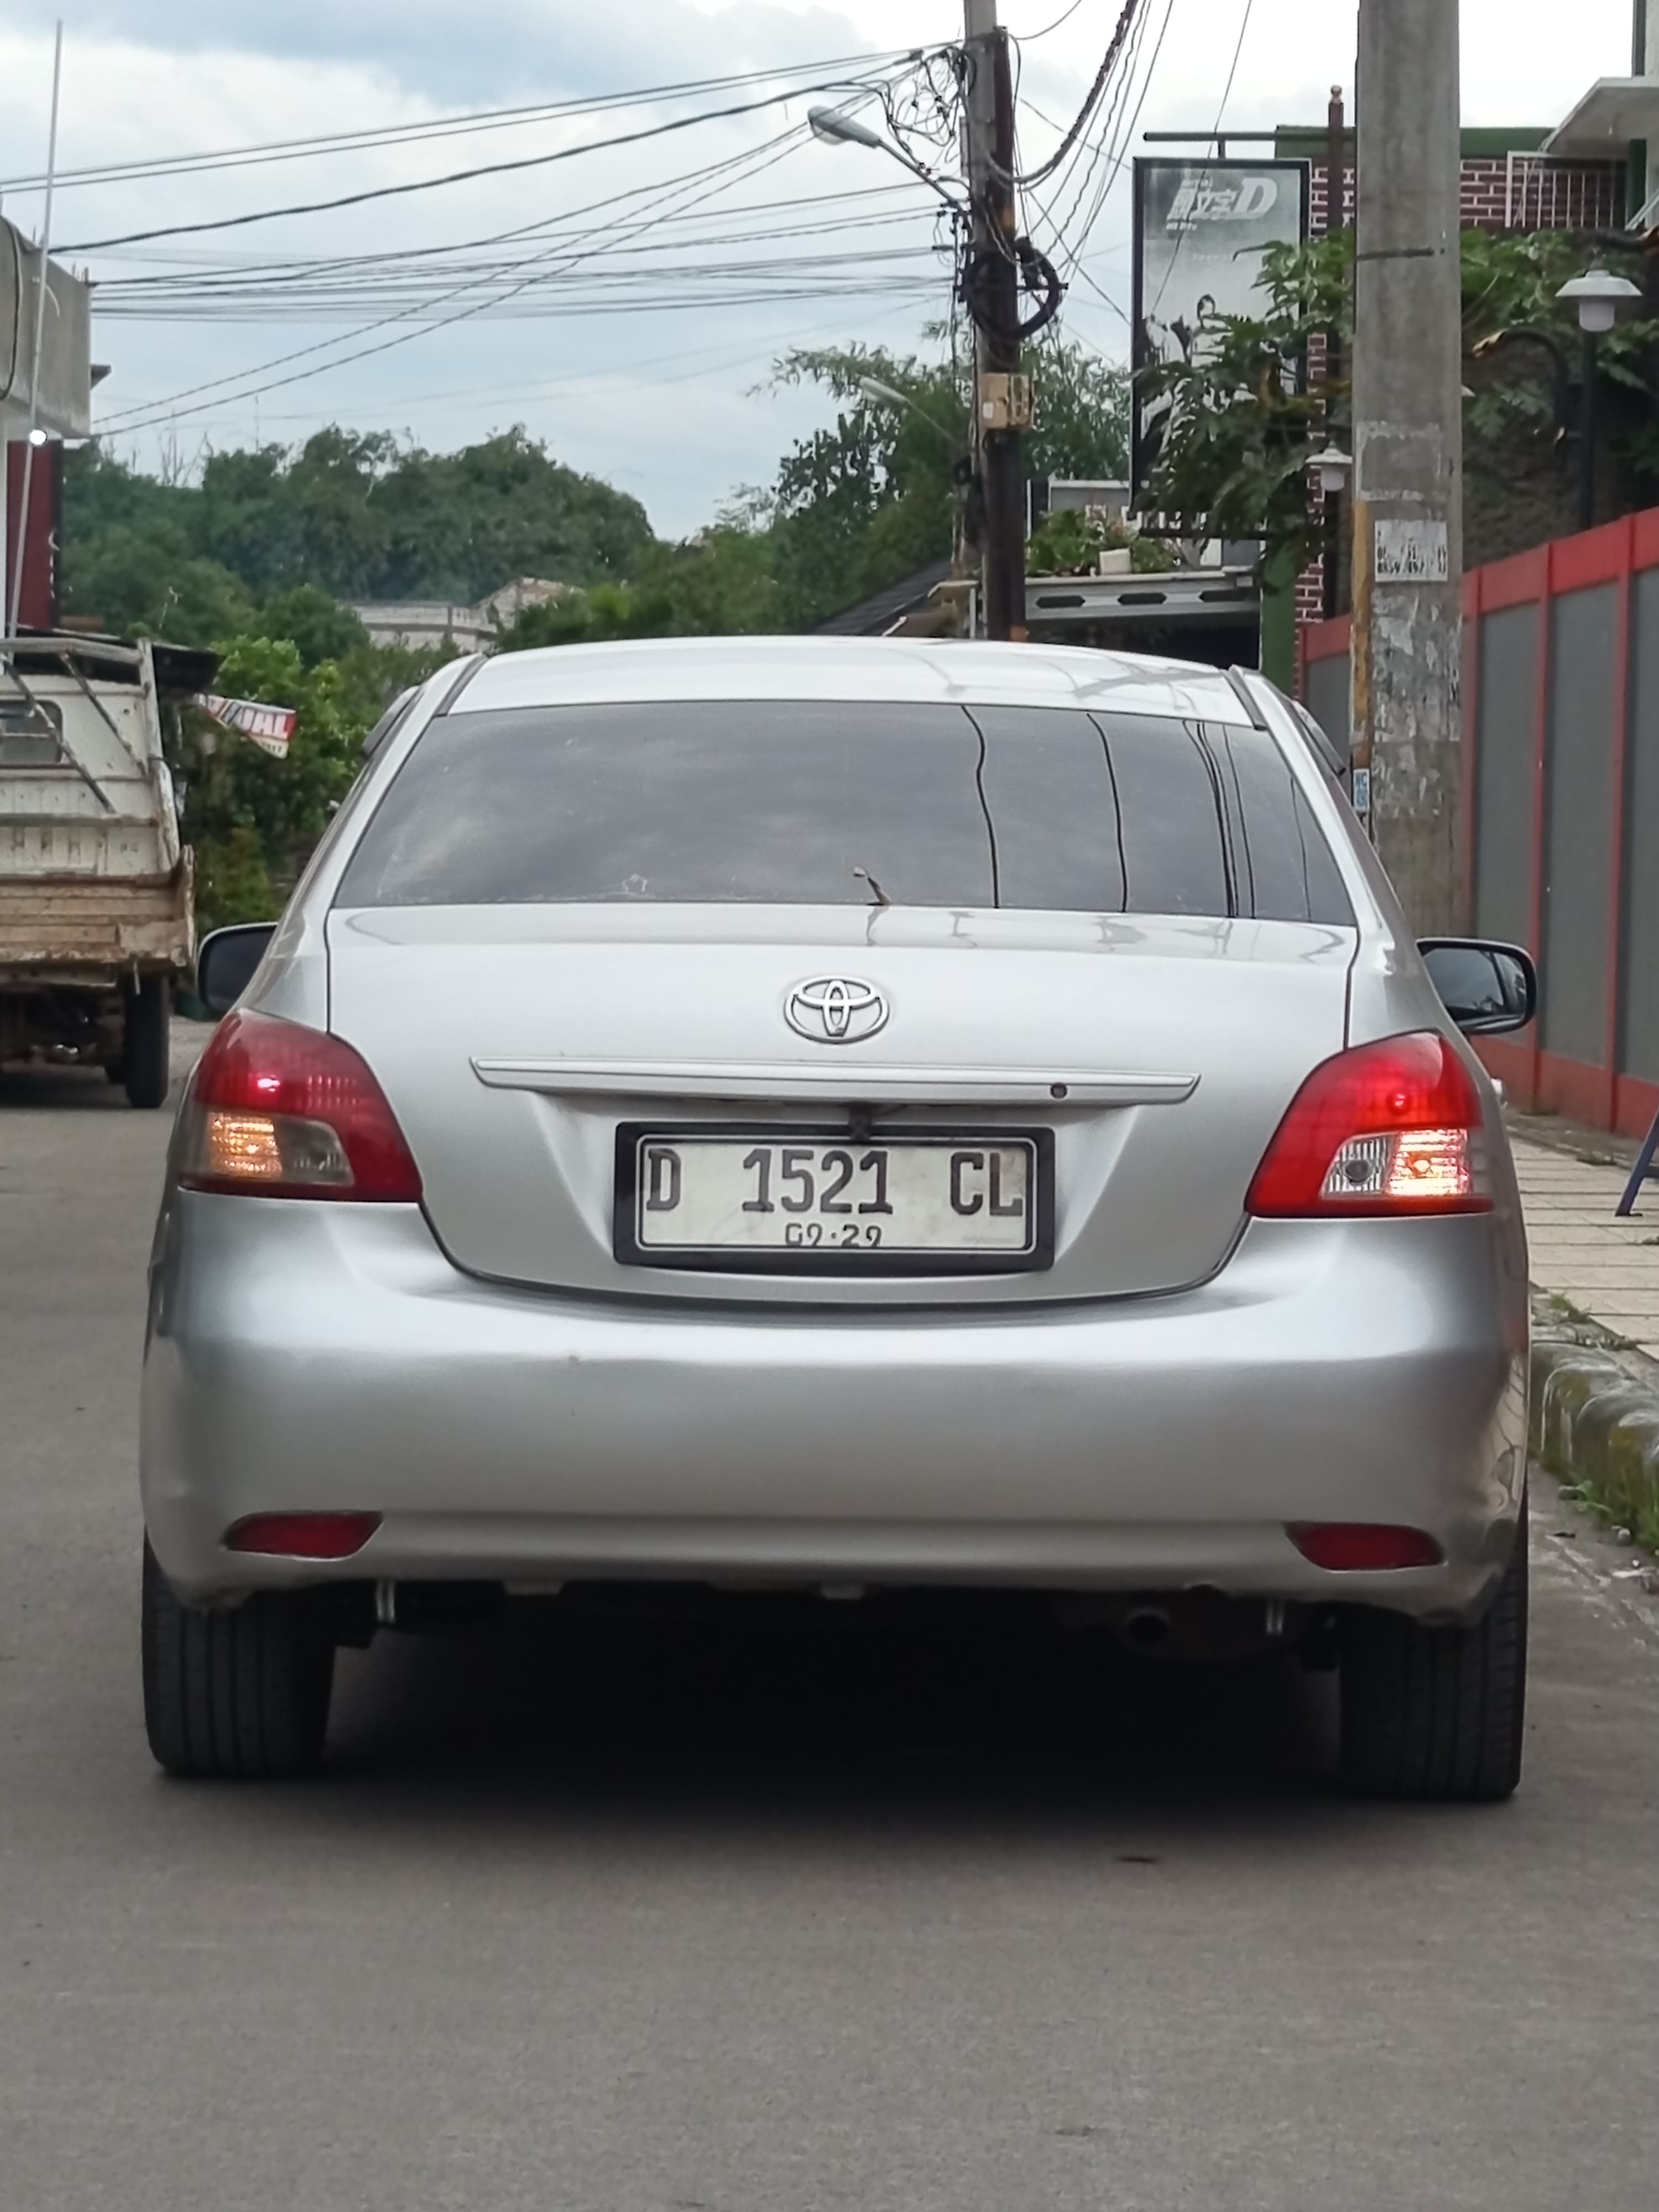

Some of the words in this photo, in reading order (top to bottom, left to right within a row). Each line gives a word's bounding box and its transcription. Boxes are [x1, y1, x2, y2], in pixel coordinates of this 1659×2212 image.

[646, 1149, 681, 1212] D
[742, 1149, 893, 1215] 1521
[950, 1152, 1023, 1217] CL
